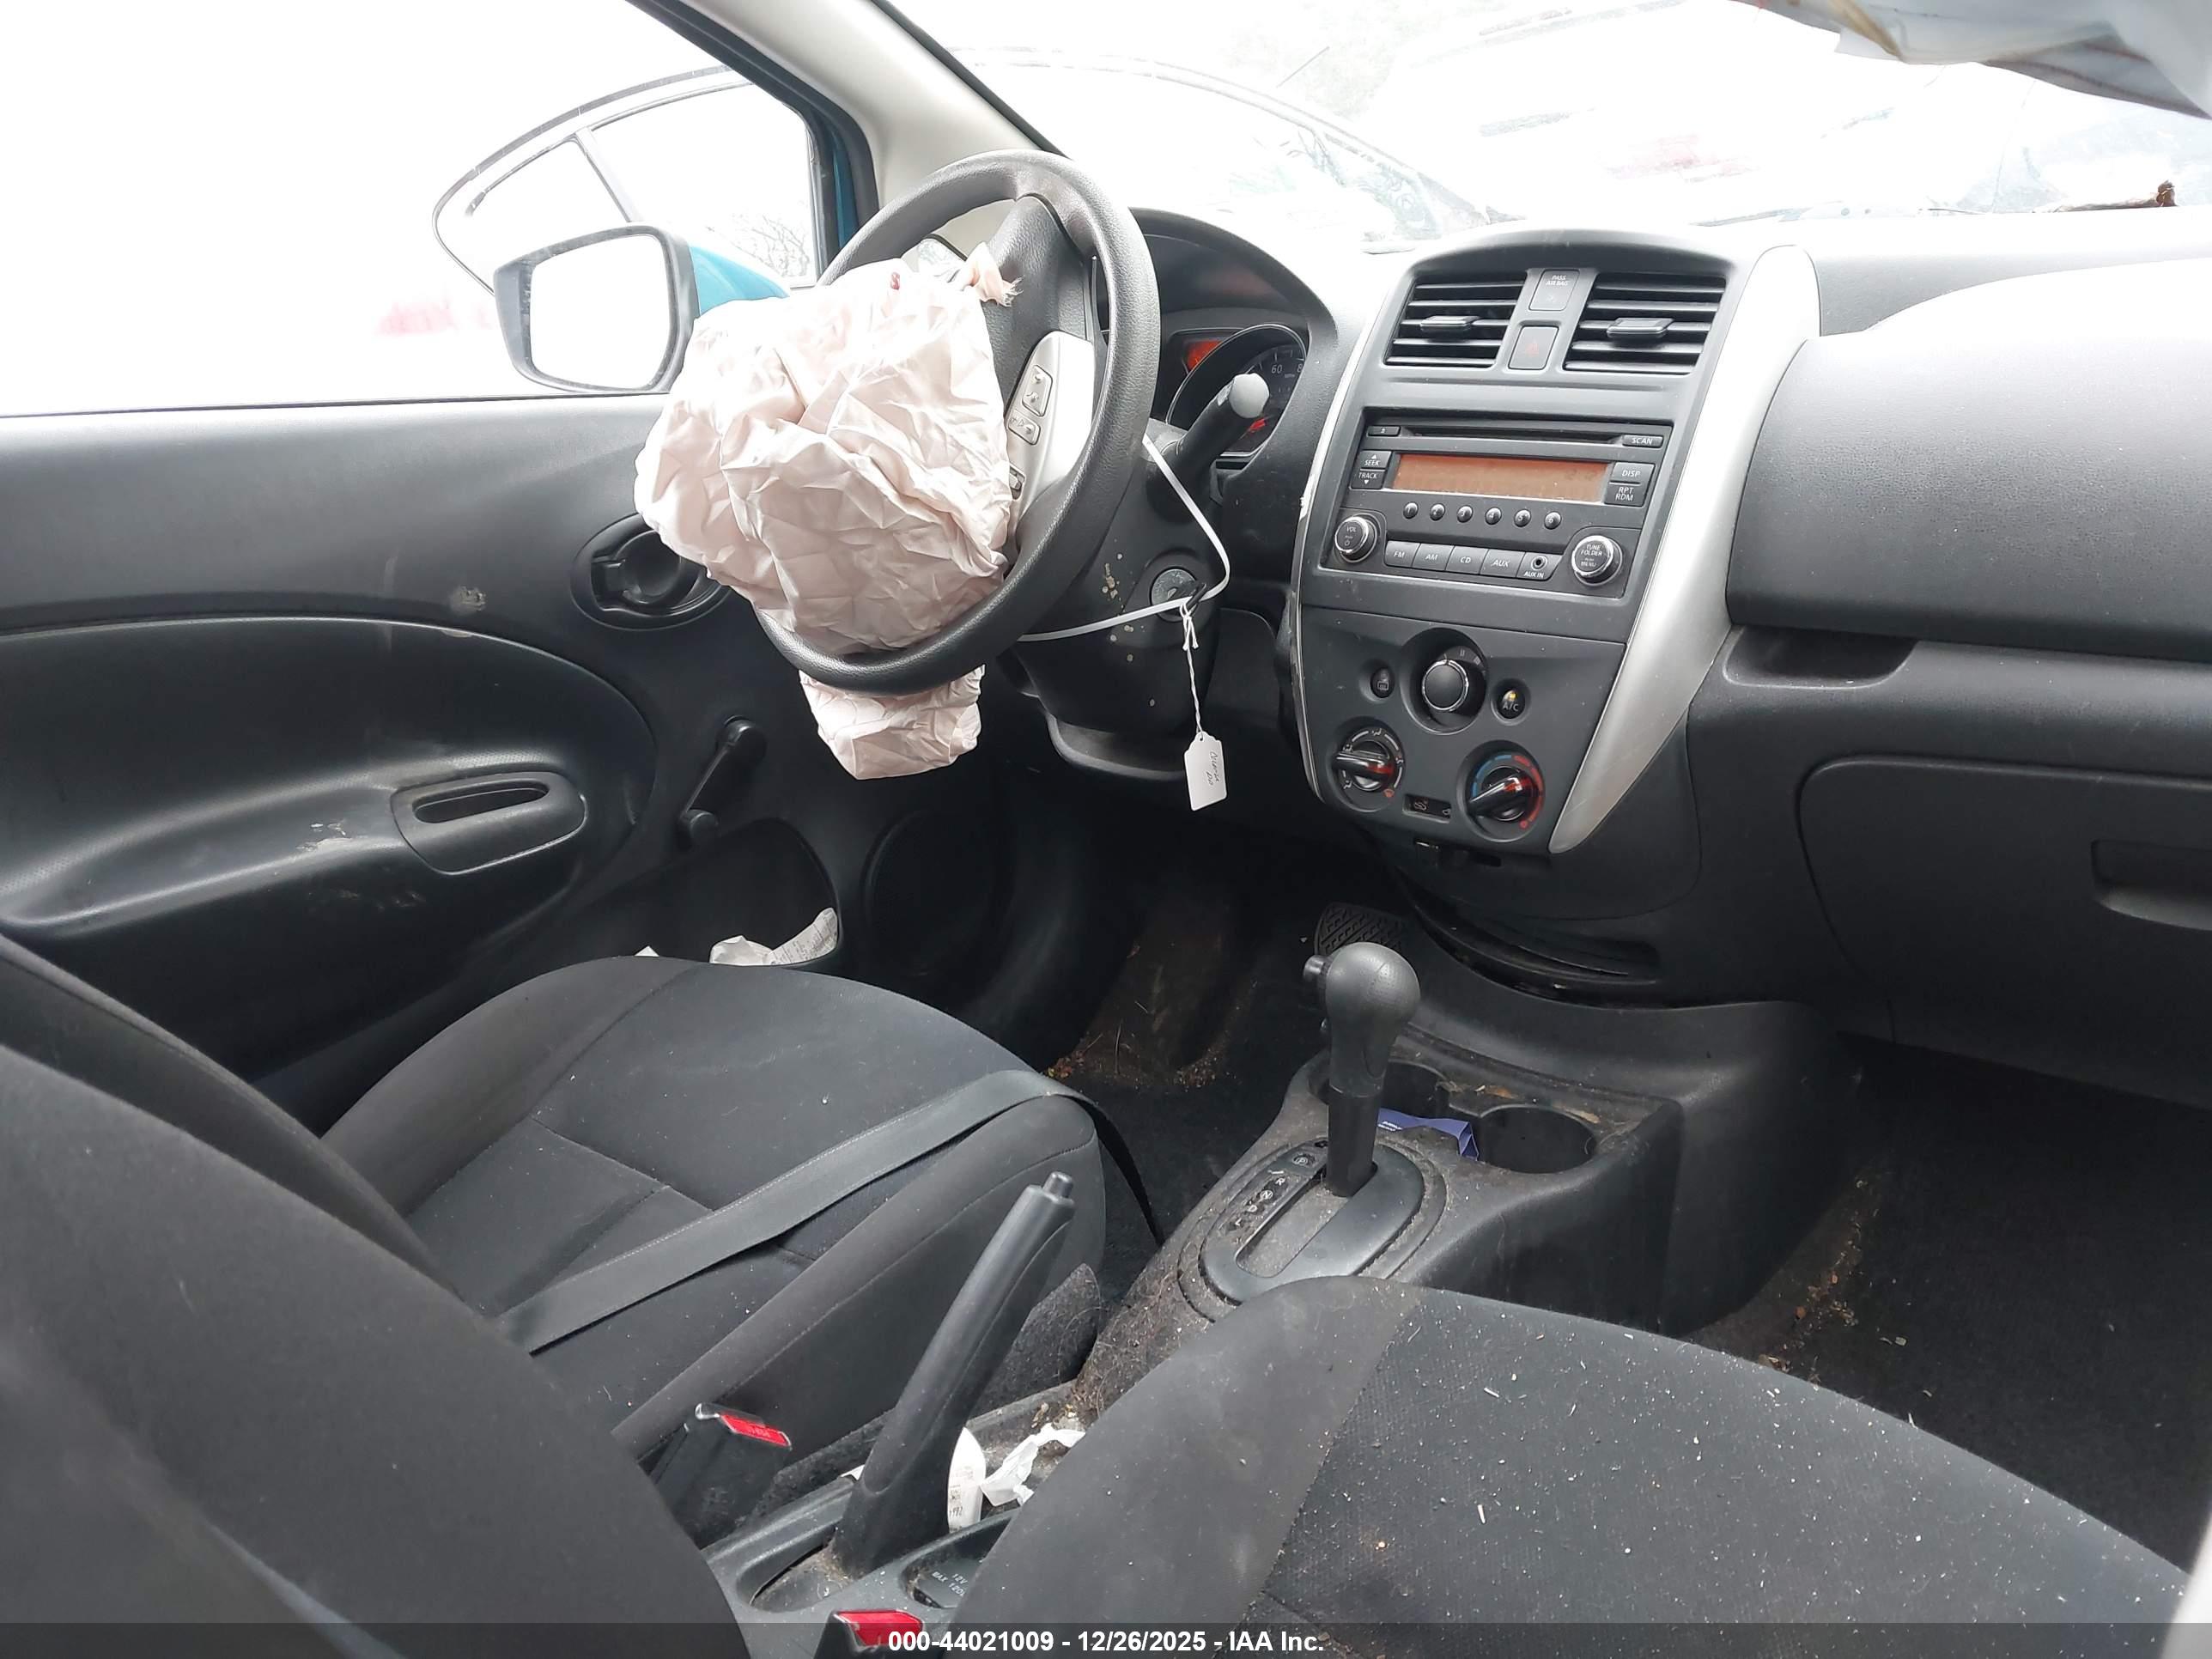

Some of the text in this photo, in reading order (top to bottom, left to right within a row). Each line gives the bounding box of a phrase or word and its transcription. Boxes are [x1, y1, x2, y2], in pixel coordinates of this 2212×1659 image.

[1271, 364, 1283, 374] 60
[1621, 469, 1641, 477] DISP
[1618, 486, 1634, 495] RPT
[1615, 493, 1634, 501] RDM
[1394, 550, 1405, 559] FM
[1460, 556, 1472, 564] CD
[1492, 558, 1510, 568] AUX
[1503, 701, 1519, 712] A/C
[1275, 1177, 1285, 1186] R
[1248, 1204, 1258, 1212] D
[1236, 1218, 1242, 1226] L
[952, 1573, 968, 1584] 12V
